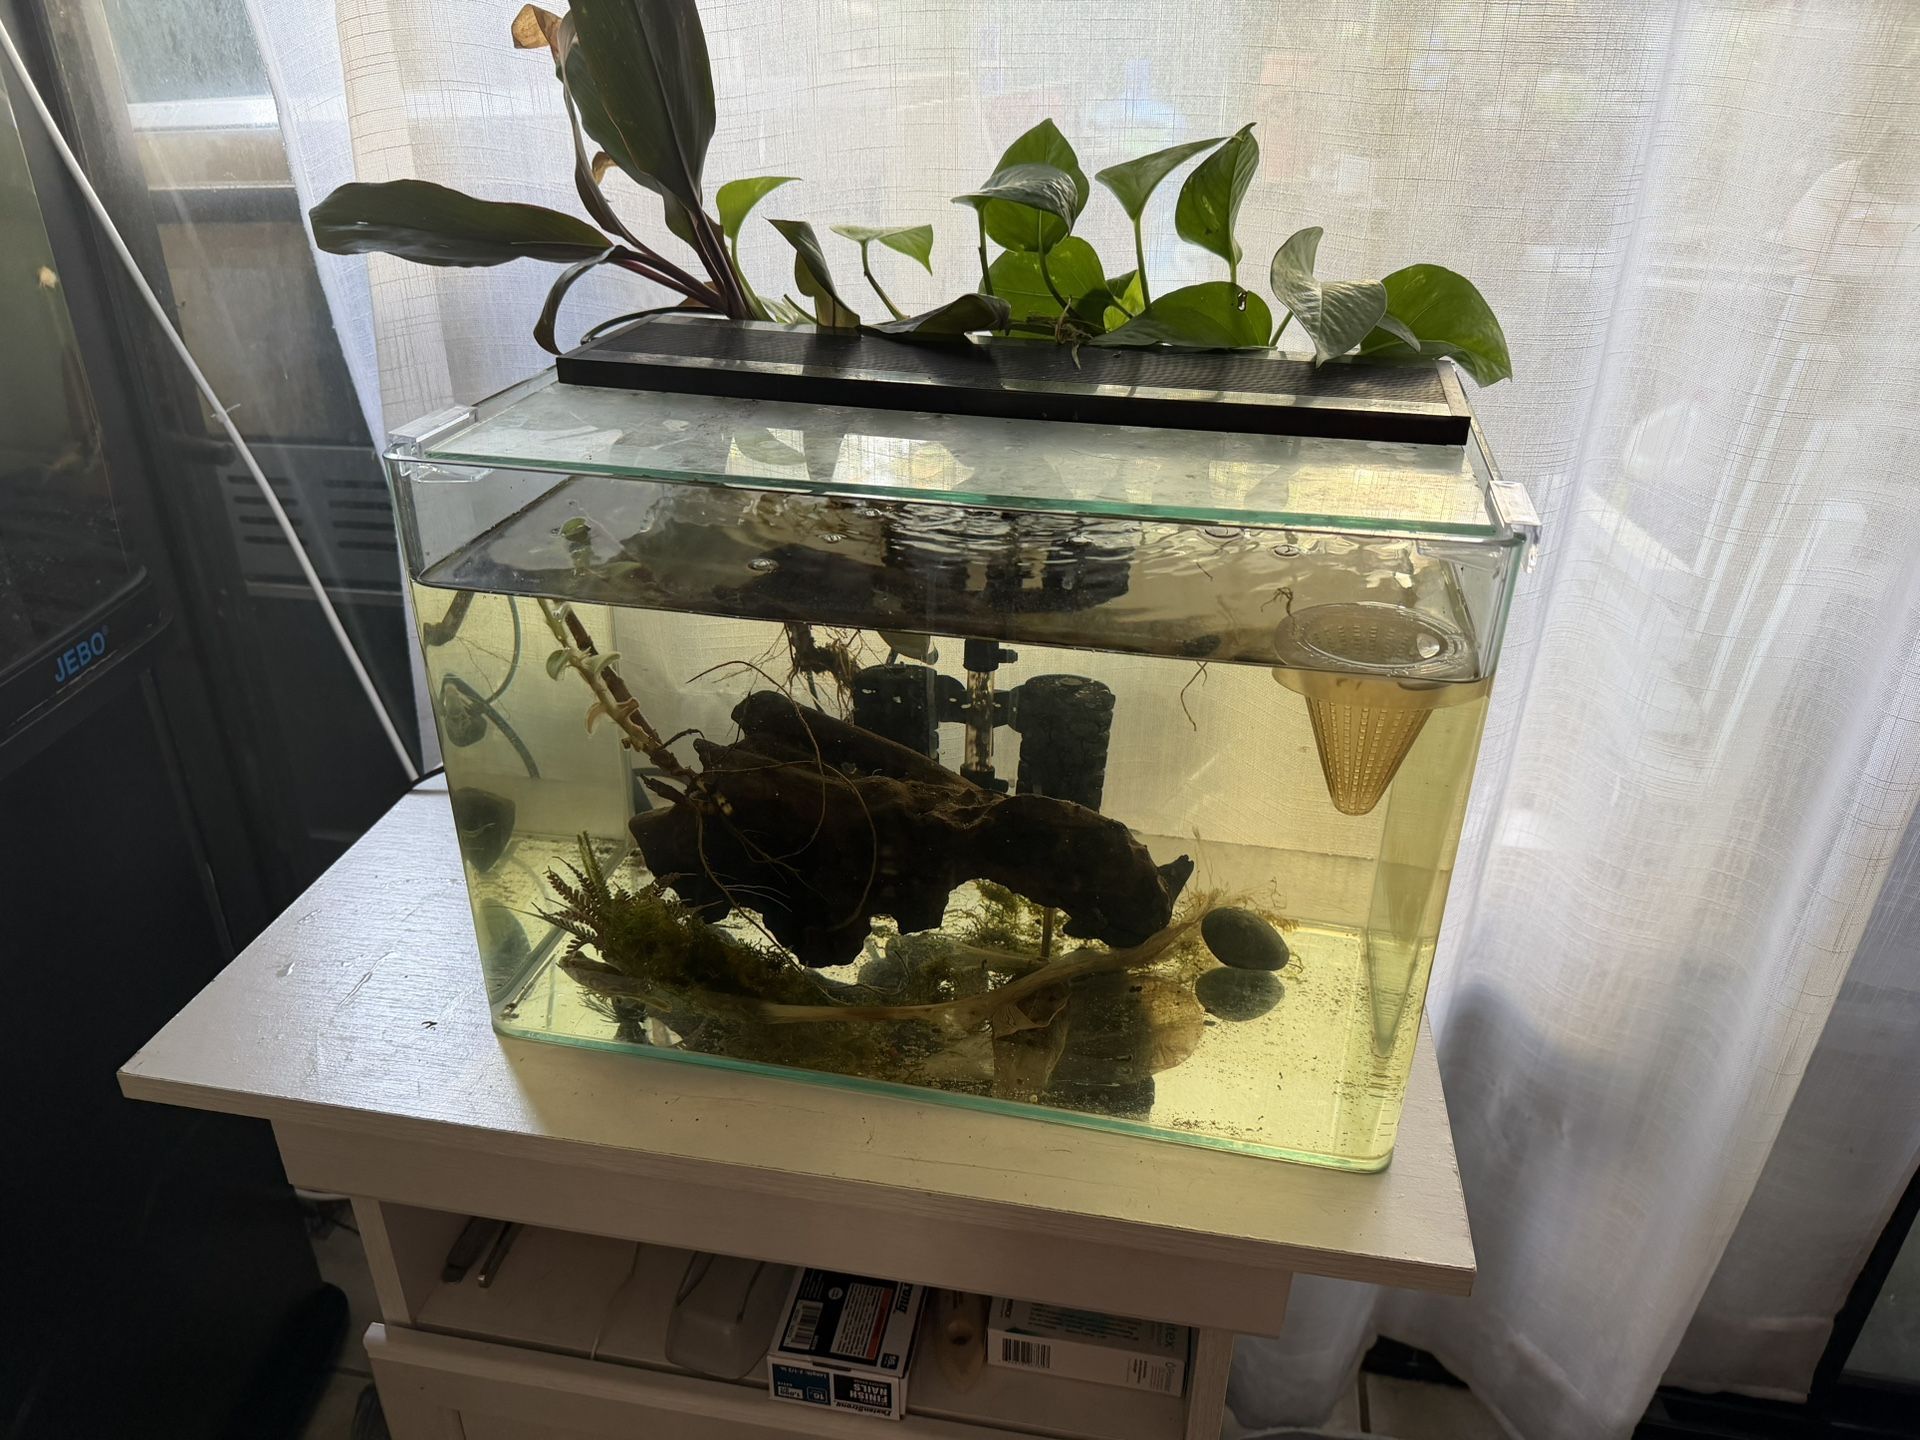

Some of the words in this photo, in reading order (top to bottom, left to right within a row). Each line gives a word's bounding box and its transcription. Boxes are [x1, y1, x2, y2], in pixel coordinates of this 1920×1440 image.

[55, 631, 106, 682] JEBO
[853, 1383, 888, 1396] NAILS
[849, 1390, 888, 1403] FINISH
